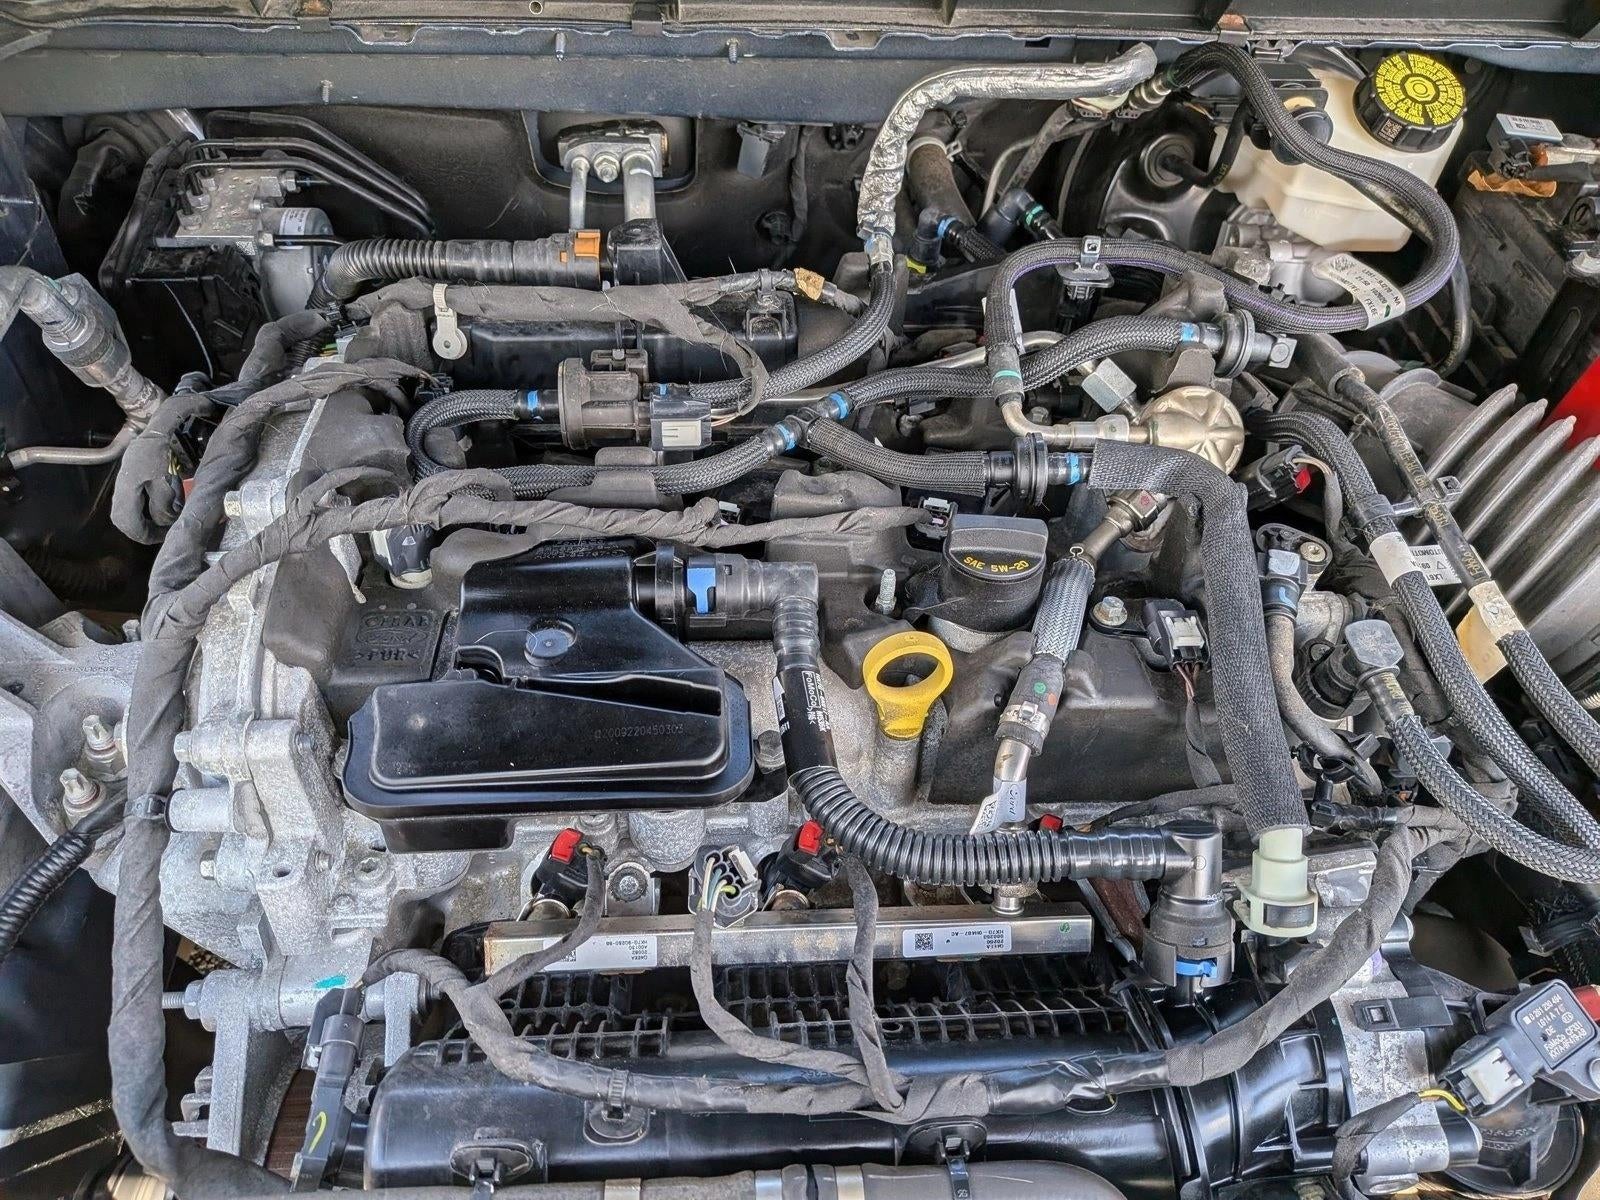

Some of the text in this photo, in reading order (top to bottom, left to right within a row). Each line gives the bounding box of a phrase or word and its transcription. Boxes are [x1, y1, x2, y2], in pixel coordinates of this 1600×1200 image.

[963, 556, 1029, 573] SAE 5W-20
[804, 671, 819, 706] FoMoCo
[1545, 1025, 1556, 1036] DE
